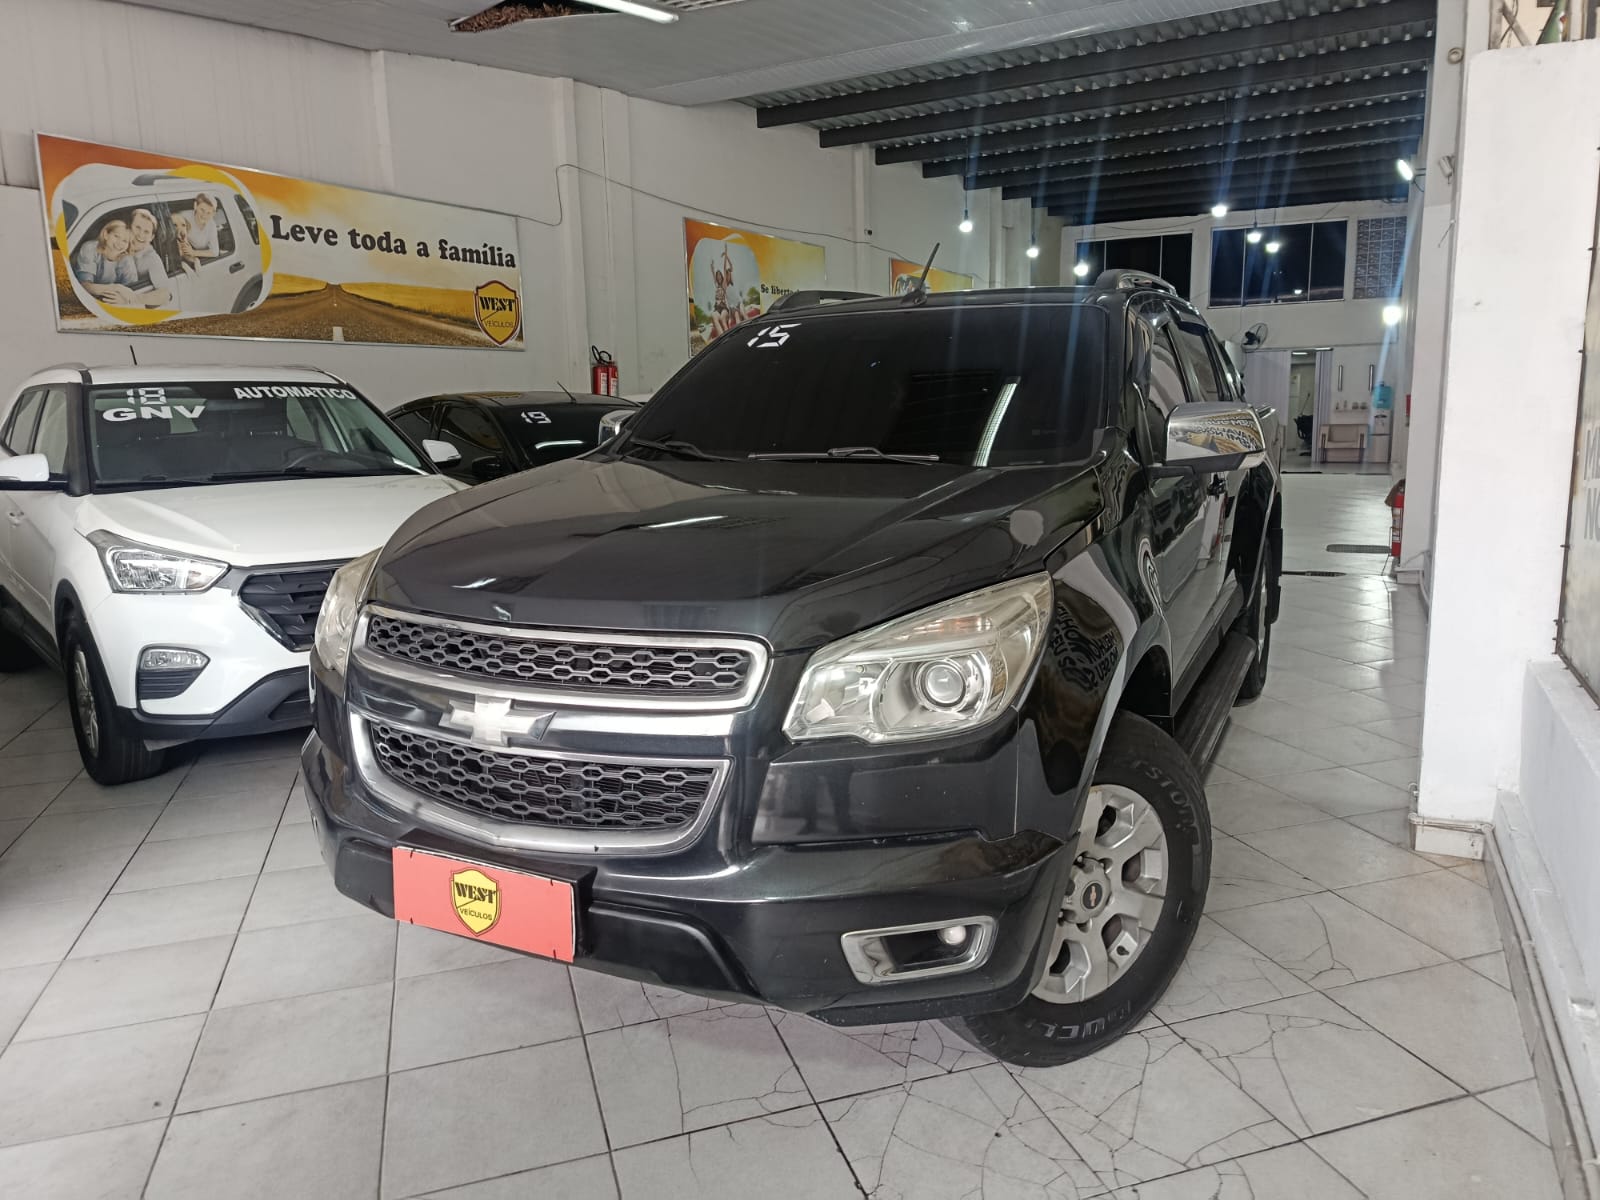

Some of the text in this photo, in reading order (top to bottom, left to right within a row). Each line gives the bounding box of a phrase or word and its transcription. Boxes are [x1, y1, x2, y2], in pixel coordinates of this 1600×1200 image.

[270, 215, 517, 268] Leve toda a família
[479, 296, 516, 312] WEST
[747, 322, 802, 348] 15
[233, 385, 357, 401] AUTOMATICO
[102, 405, 206, 422] GNV
[520, 411, 552, 424] 19
[455, 882, 496, 904] WEST
[460, 907, 492, 921] VEÍCULOS
